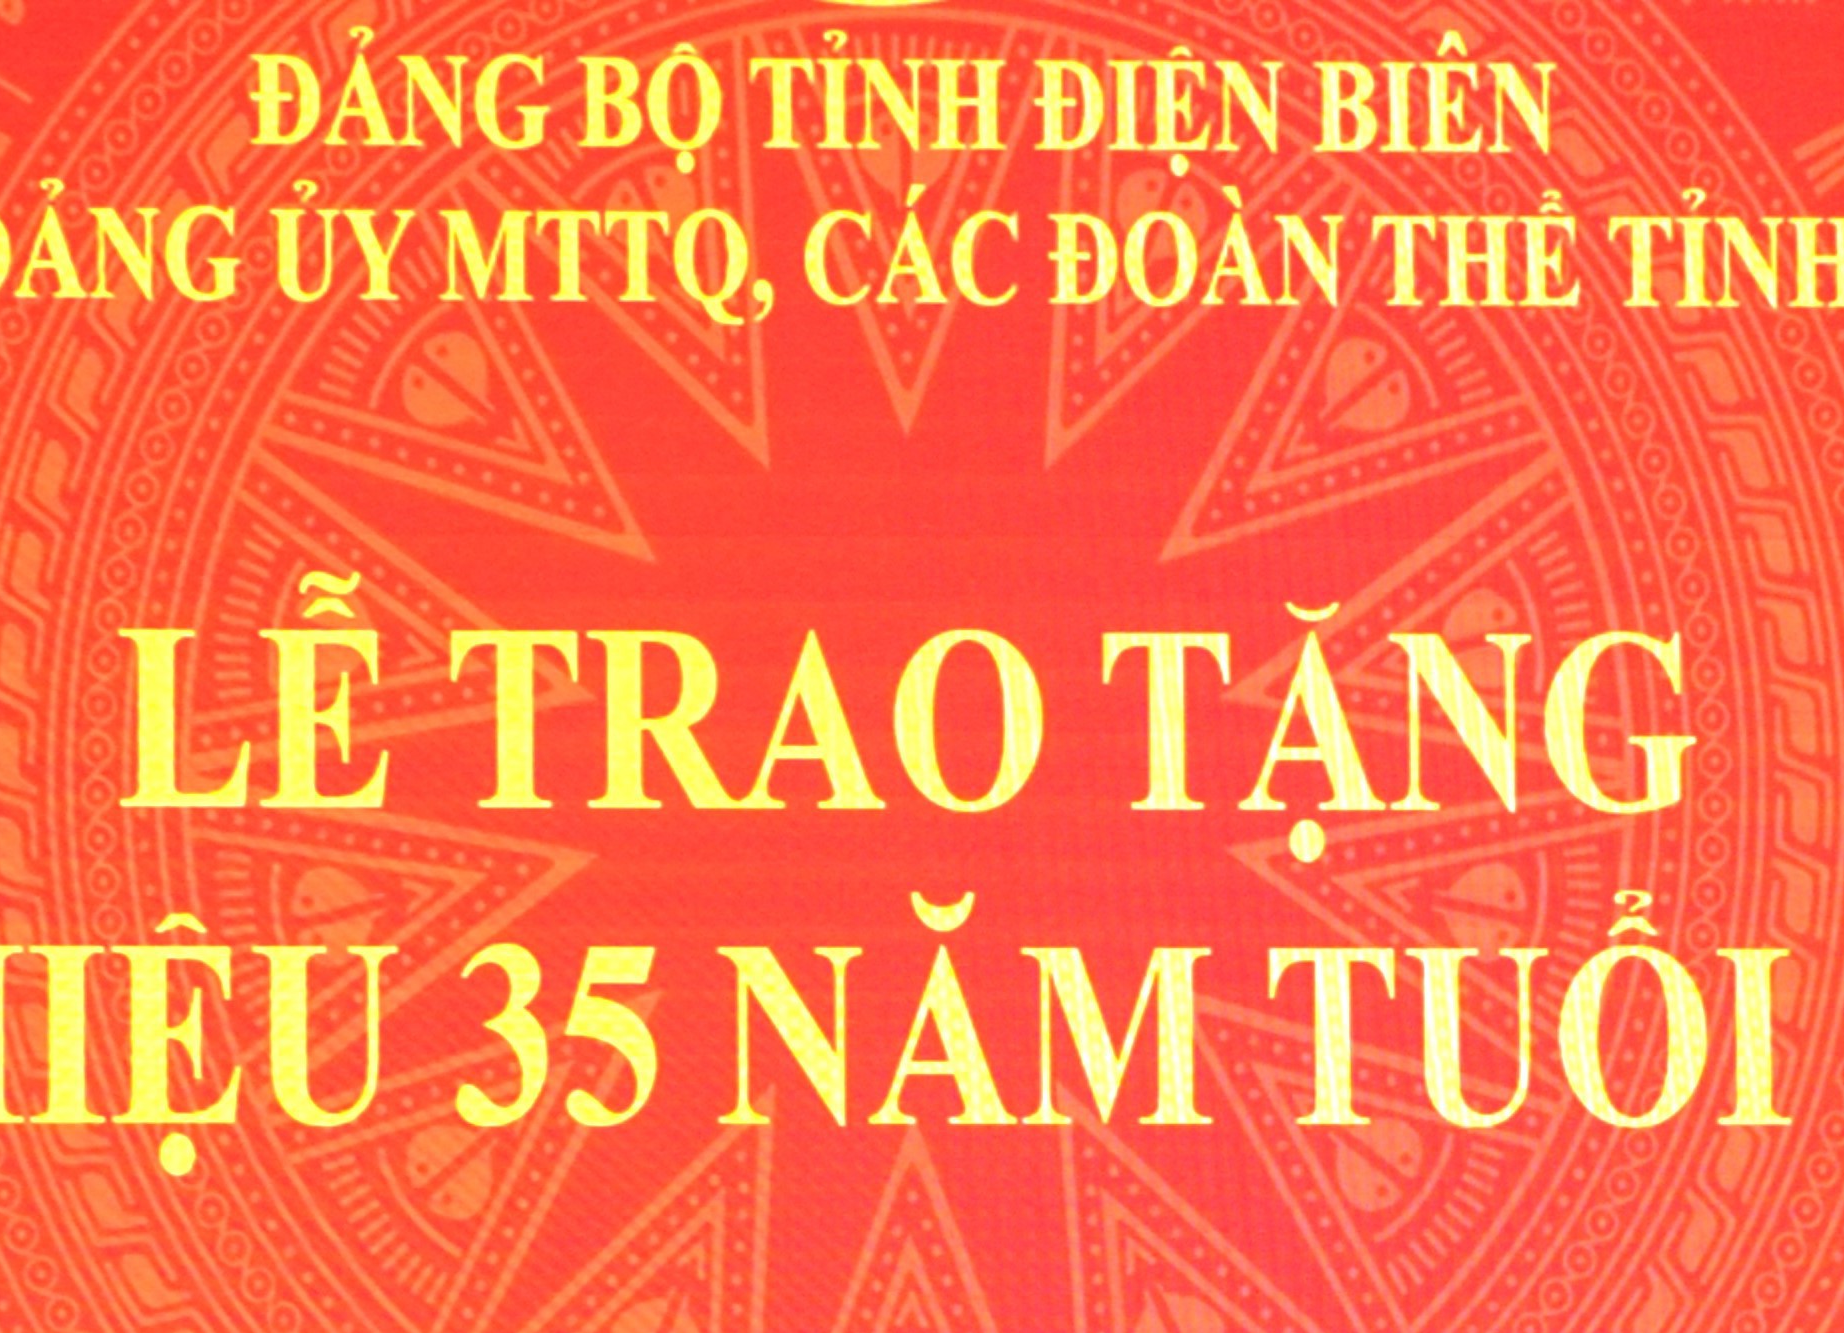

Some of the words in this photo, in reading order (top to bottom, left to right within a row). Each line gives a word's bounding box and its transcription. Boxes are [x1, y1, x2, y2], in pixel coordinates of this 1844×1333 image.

[249, 25, 551, 150] ĐẢNG
[577, 42, 722, 175] BỘ
[749, 29, 1007, 152] TỈNH
[1033, 45, 1284, 177] ĐIỆN
[1313, 29, 1557, 155] BIÊN
[269, 179, 416, 303] ỦY
[438, 207, 774, 326] MTTQ,
[803, 183, 1019, 307] CÁC
[1047, 185, 1345, 308] ĐOÀN
[1371, 188, 1581, 307] THỂ
[117, 570, 389, 814] LỄ
[449, 629, 1044, 814] TRAO
[1102, 601, 1697, 863] TẶNG
[454, 942, 658, 1130] 35
[717, 891, 1214, 1129] NĂM
[1268, 889, 1793, 1130] TUỔI
